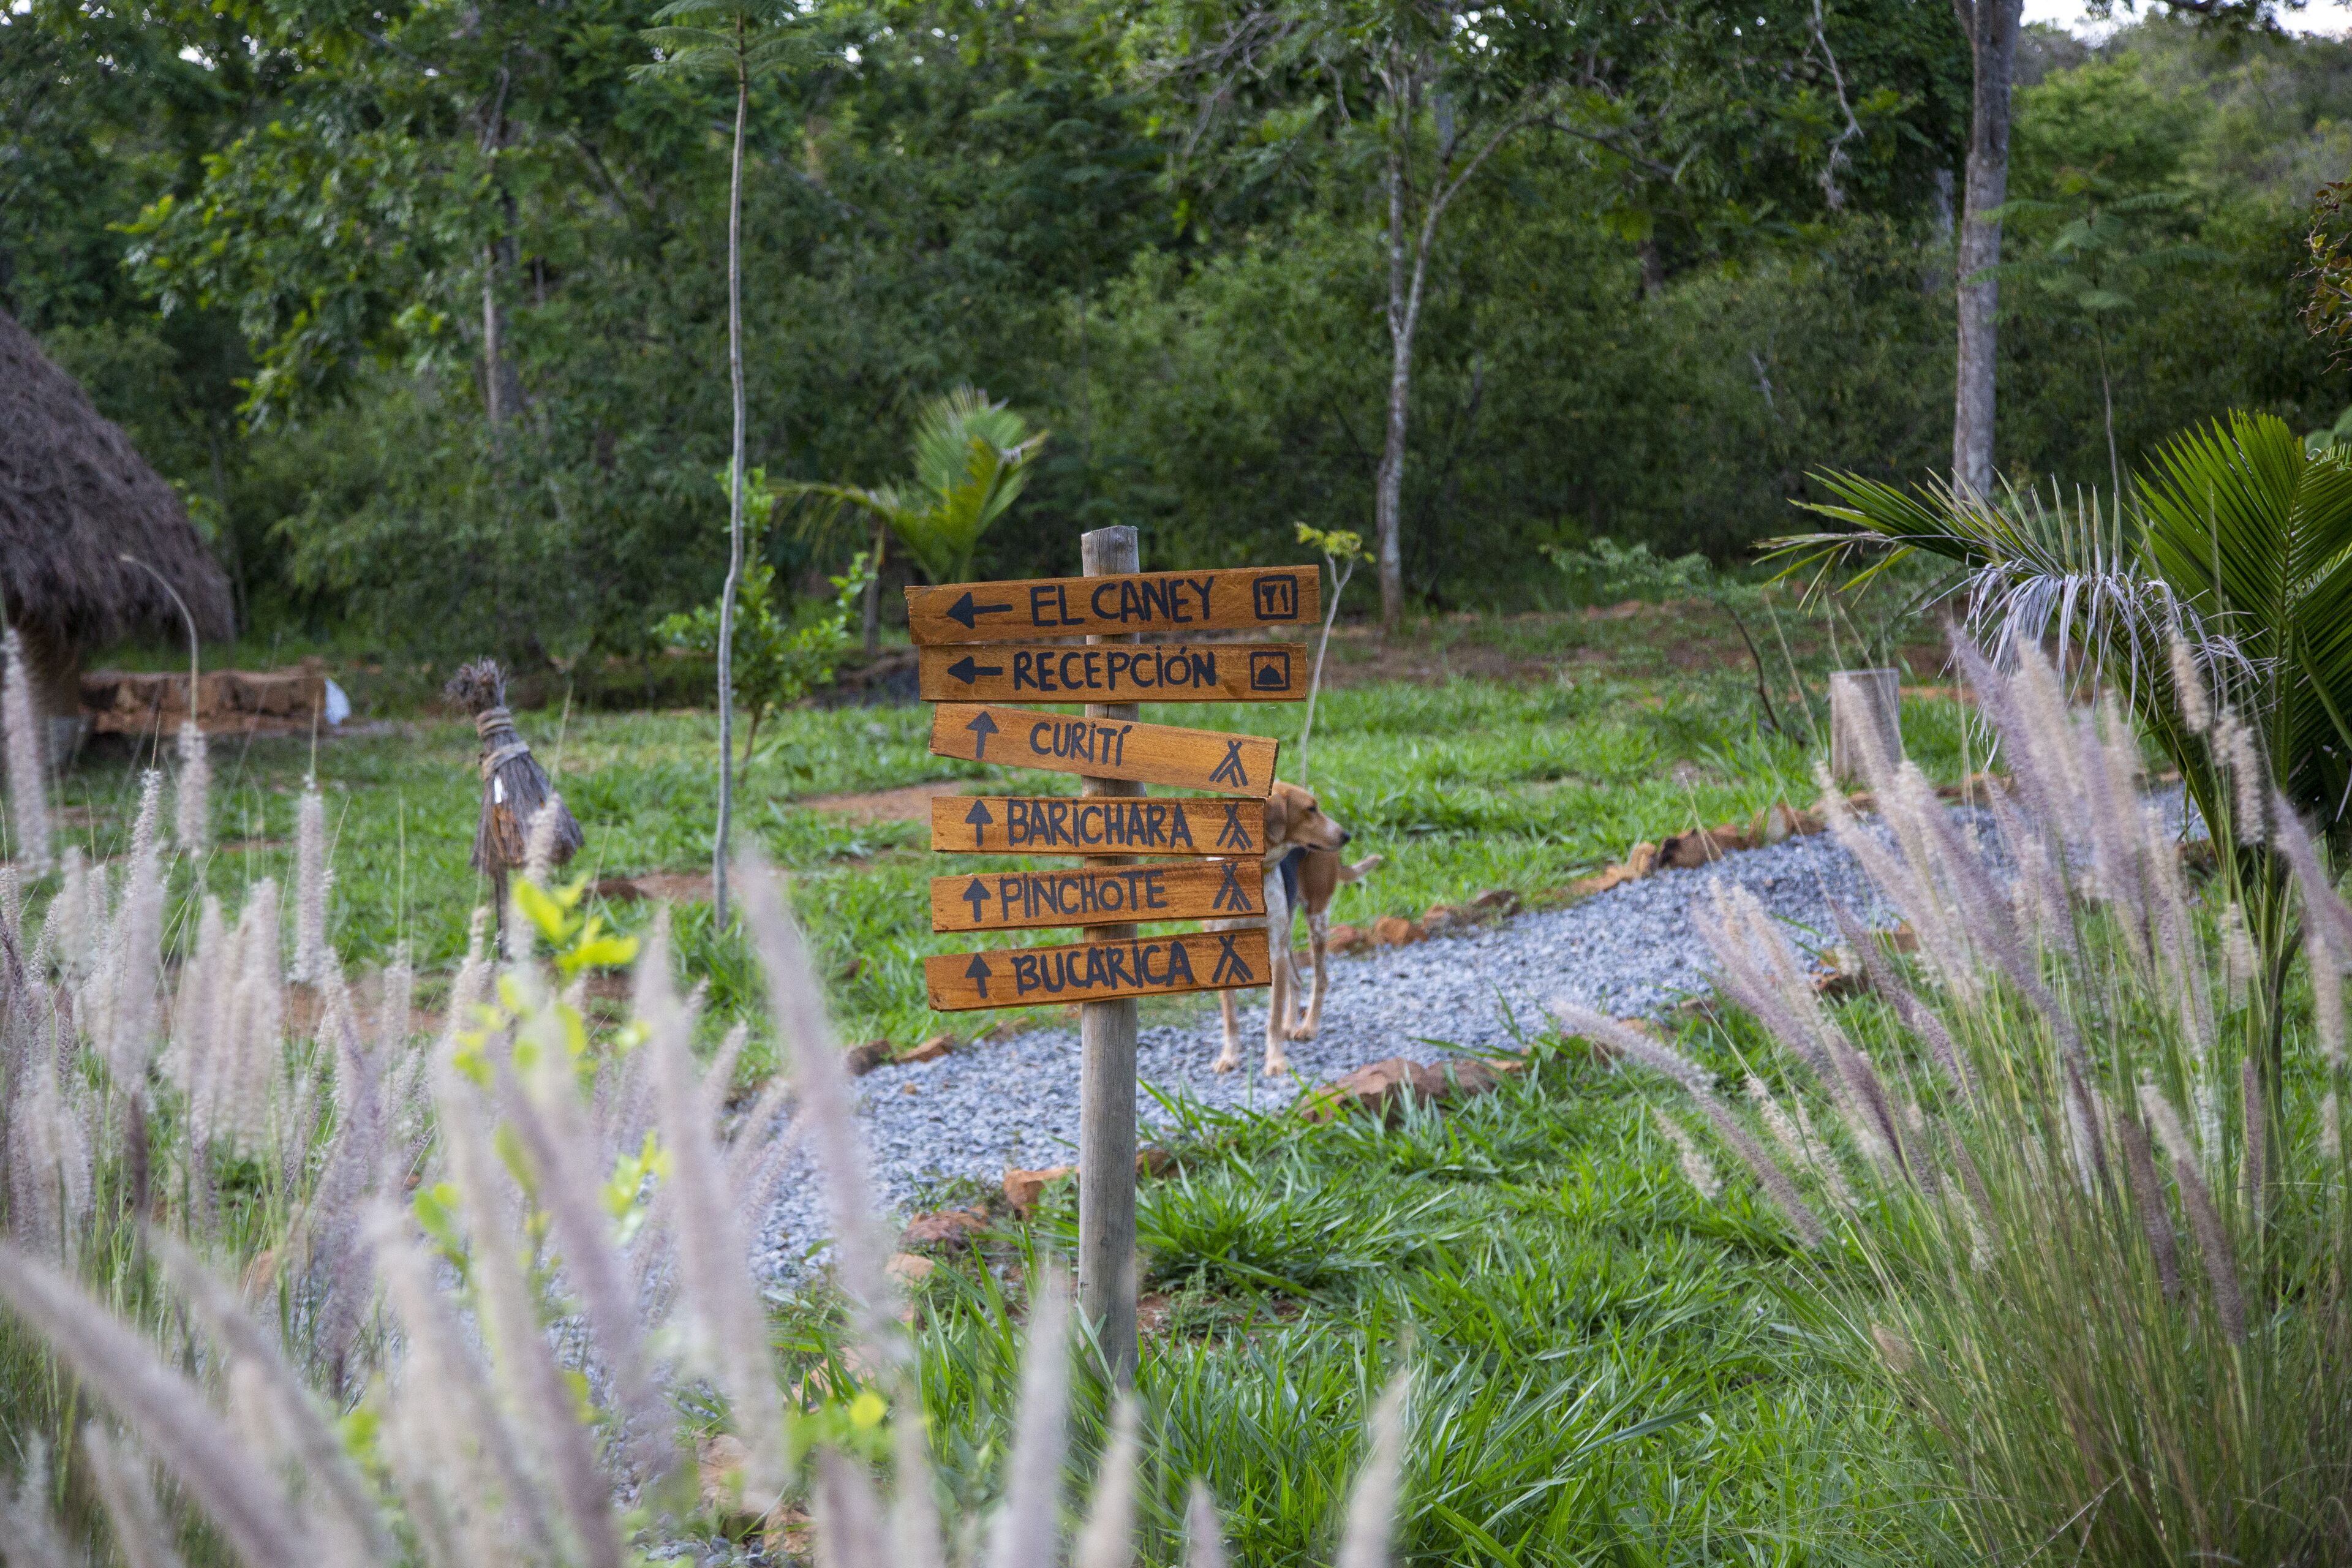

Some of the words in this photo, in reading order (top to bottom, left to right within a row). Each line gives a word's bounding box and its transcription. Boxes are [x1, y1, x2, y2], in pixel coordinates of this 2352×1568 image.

[1030, 586, 1084, 627] EL
[1091, 576, 1215, 624] CANEY
[1013, 645, 1216, 692] RECEPCIÓN
[1007, 799, 1193, 848] BARICHARA
[1000, 870, 1167, 921] PINCHOTE
[1011, 940, 1193, 996] BUCARICA
